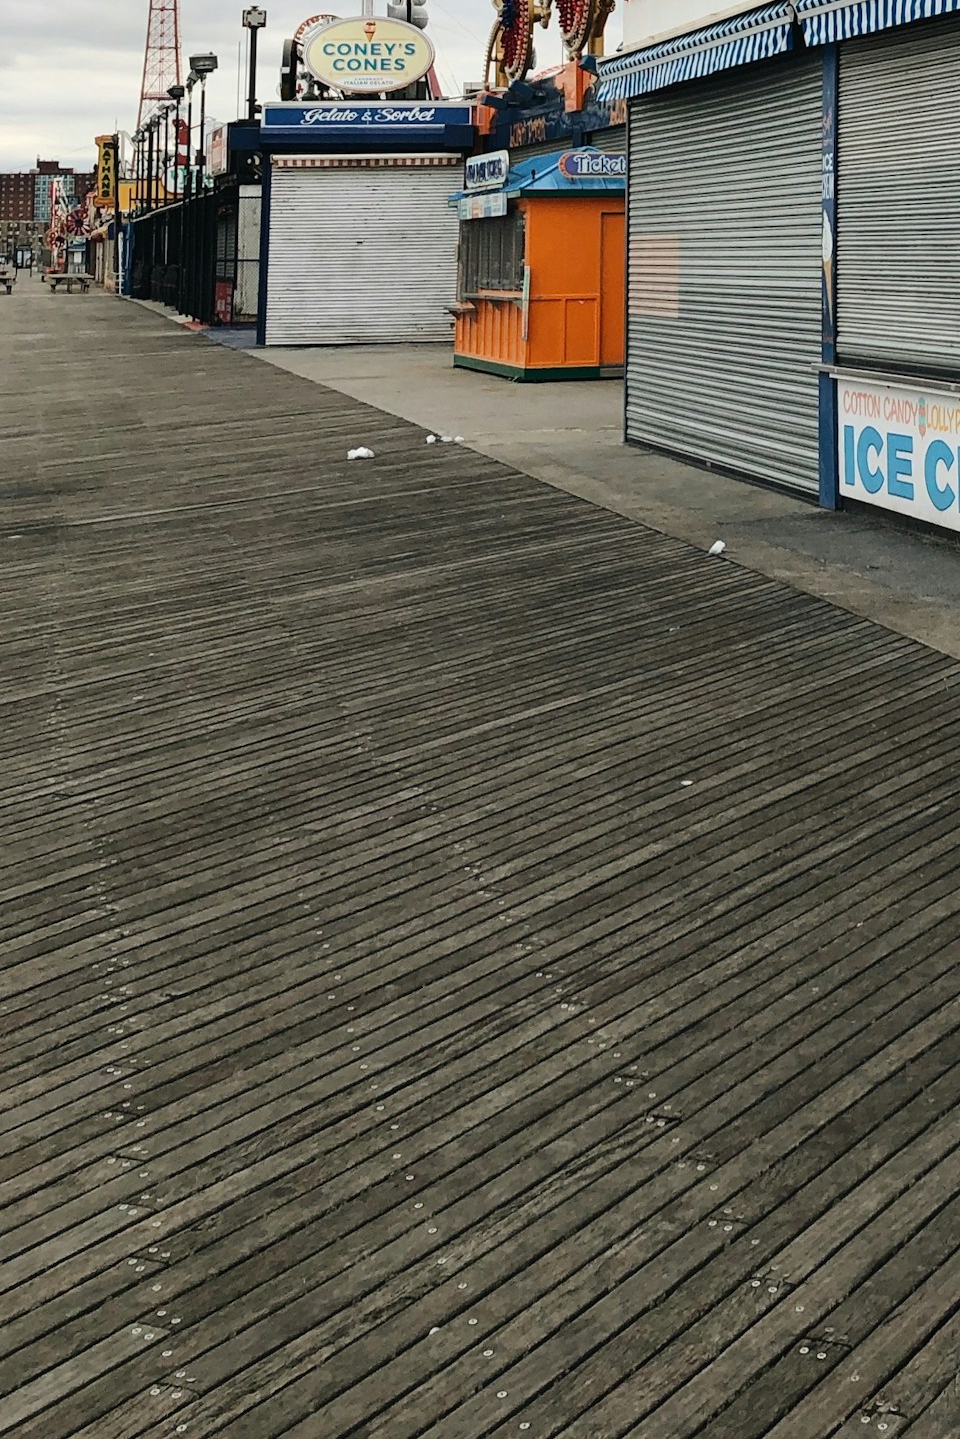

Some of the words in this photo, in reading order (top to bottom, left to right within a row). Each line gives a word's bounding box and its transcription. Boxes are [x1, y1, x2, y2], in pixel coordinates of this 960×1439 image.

[322, 42, 416, 56] CONEY'S
[332, 58, 406, 71] CONES
[300, 108, 359, 125] Gelato
[361, 109, 373, 124] &
[375, 108, 435, 122] Sorbet
[573, 154, 626, 175] Ticket
[842, 389, 881, 420] COTTON
[883, 397, 918, 427] CANDY
[843, 424, 914, 501] ICE
